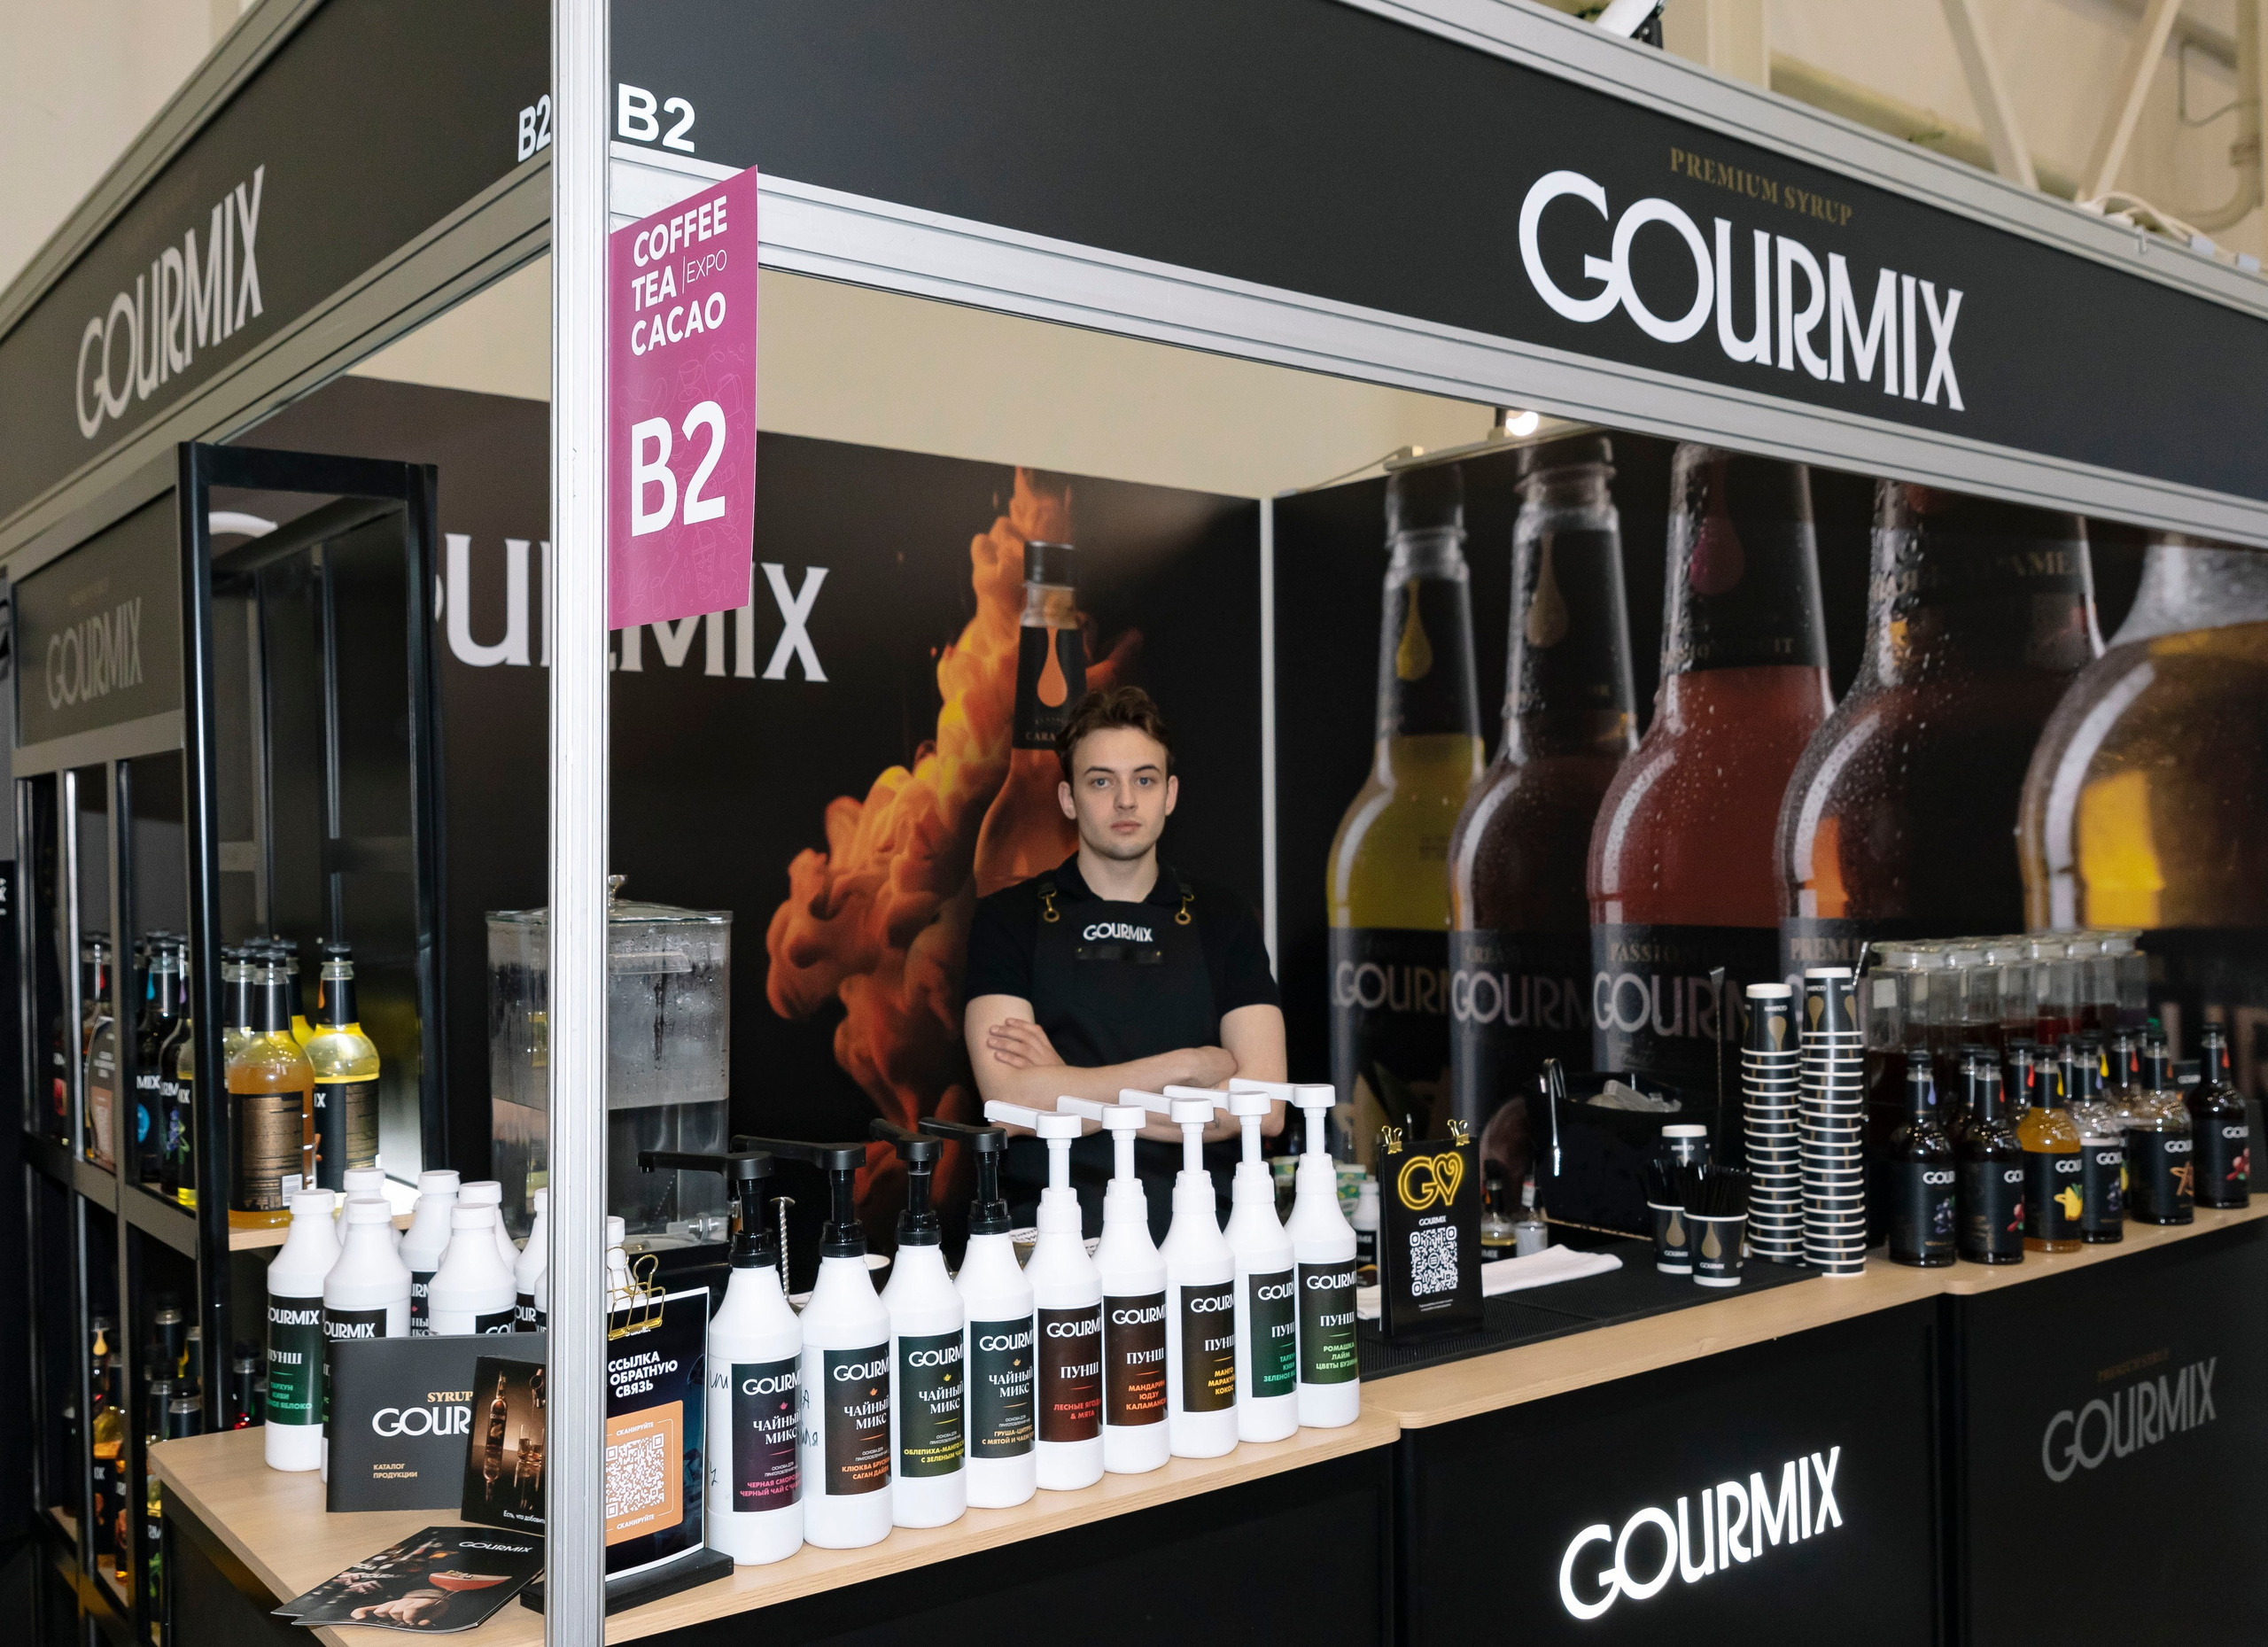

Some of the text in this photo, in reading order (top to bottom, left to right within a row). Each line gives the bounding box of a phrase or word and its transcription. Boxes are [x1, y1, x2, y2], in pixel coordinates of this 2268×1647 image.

[617, 82, 695, 153] B2
[518, 94, 552, 163] B2
[1671, 147, 1852, 226] PREMIUM SYRUP
[633, 195, 728, 268] COFFEE
[631, 249, 728, 311] TEA EXPO
[1518, 170, 1965, 412] GOURMIX
[76, 164, 265, 440] GOURMIX
[631, 291, 726, 356] CACAO
[631, 400, 726, 538] B2
[46, 596, 143, 709] GOURMIX
[1083, 922, 1153, 942] GOURMIX
[268, 1307, 320, 1325] OURMIX
[1320, 1311, 1355, 1327] ПУНШ
[322, 1321, 376, 1338] OURMIX
[1126, 1347, 1164, 1364] ПУНШ
[1323, 1342, 1355, 1352] РОМАШКА
[608, 1351, 660, 1372] ССЫЛКА
[1332, 1351, 1350, 1361] ЛАЙМ
[610, 1360, 678, 1386] ОБРАТНУЮ
[1060, 1361, 1099, 1379] ПУНШ
[1214, 1366, 1234, 1378] МАНГО
[1316, 1362, 1339, 1371] ЦВЕТЫ
[989, 1365, 1033, 1386] ЧАЙНЫЙ
[1263, 1371, 1290, 1382] ЗЕЛЕНОЕ
[427, 1391, 473, 1402] SYRUP
[616, 1381, 654, 1398] СВЯЗЬ
[999, 1382, 1029, 1398] МИКС
[1139, 1391, 1159, 1400] ЮДЗУ
[1215, 1384, 1234, 1395] КОКОС
[930, 1398, 960, 1414] МИКС
[1053, 1402, 1084, 1410] ЛЕСНЫЕ
[1078, 1410, 1095, 1418] МЯТА
[856, 1412, 887, 1430] МИКС
[2041, 1356, 2218, 1483] GOURMIX
[616, 1421, 654, 1436] СКАНИРУЙТЕ
[765, 1427, 797, 1445] МИКС
[904, 1442, 959, 1456] ОБЛЕПИХА-МАНГО
[927, 1452, 954, 1463] ЗЕЛЕНЫМ
[373, 1471, 417, 1480] ПРОДУКЦИИ
[842, 1463, 872, 1472] КЛЮКВА
[852, 1471, 874, 1480] САГАН
[740, 1485, 769, 1497] ЧЕРНЫЙ
[770, 1484, 784, 1496] ЧАЙ
[617, 1514, 655, 1531] СКАНИРУЙТЕ
[1559, 1446, 1843, 1620] GOURMIX
[459, 1542, 532, 1553] GOURMIX
